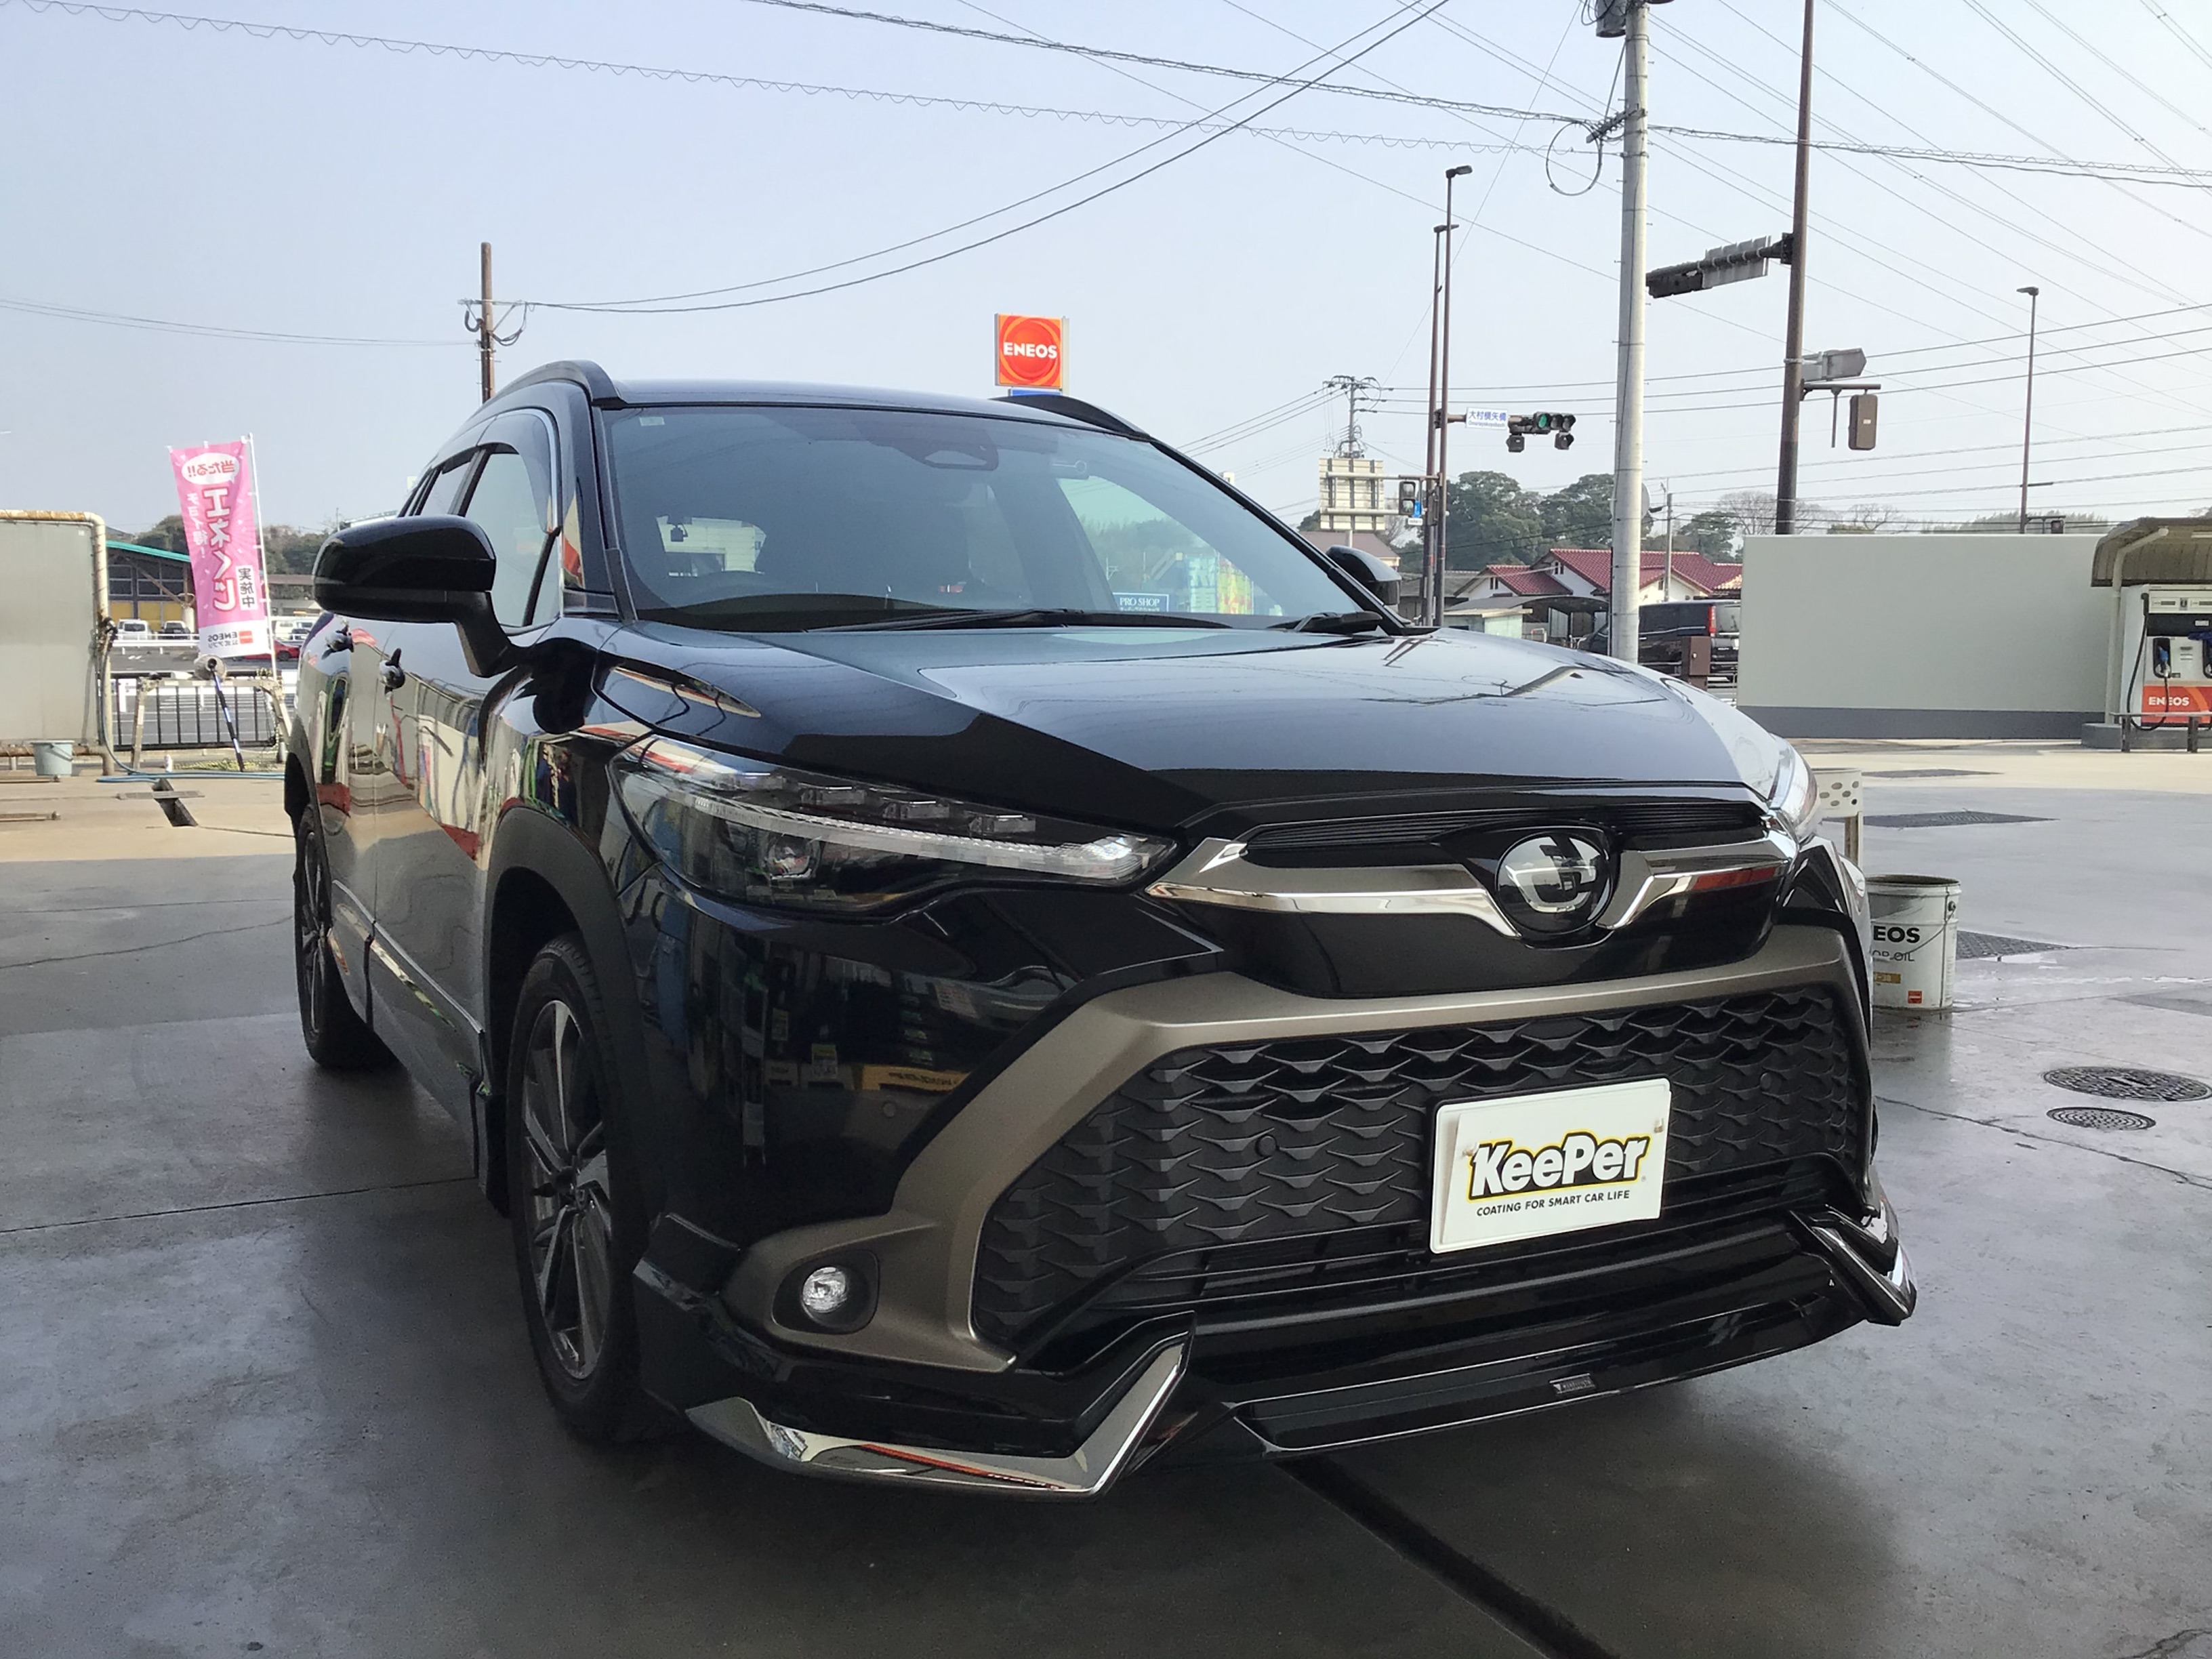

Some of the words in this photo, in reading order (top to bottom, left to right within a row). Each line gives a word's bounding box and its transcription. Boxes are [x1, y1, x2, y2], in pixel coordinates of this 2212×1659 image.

[1003, 342, 1057, 359] ENEOS
[1120, 597, 1137, 606] PRO
[1138, 598, 1160, 607] SHOP
[2148, 697, 2190, 706] ENEOS
[1873, 926, 1920, 943] EOS
[1894, 951, 1914, 962] OIL
[1469, 1131, 1650, 1200] KeePer
[1476, 1202, 1521, 1216] COATING
[1525, 1199, 1545, 1210] FOR
[1549, 1195, 1581, 1207] SMART
[1584, 1191, 1604, 1203] CAR
[1607, 1189, 1630, 1200] LIFE
